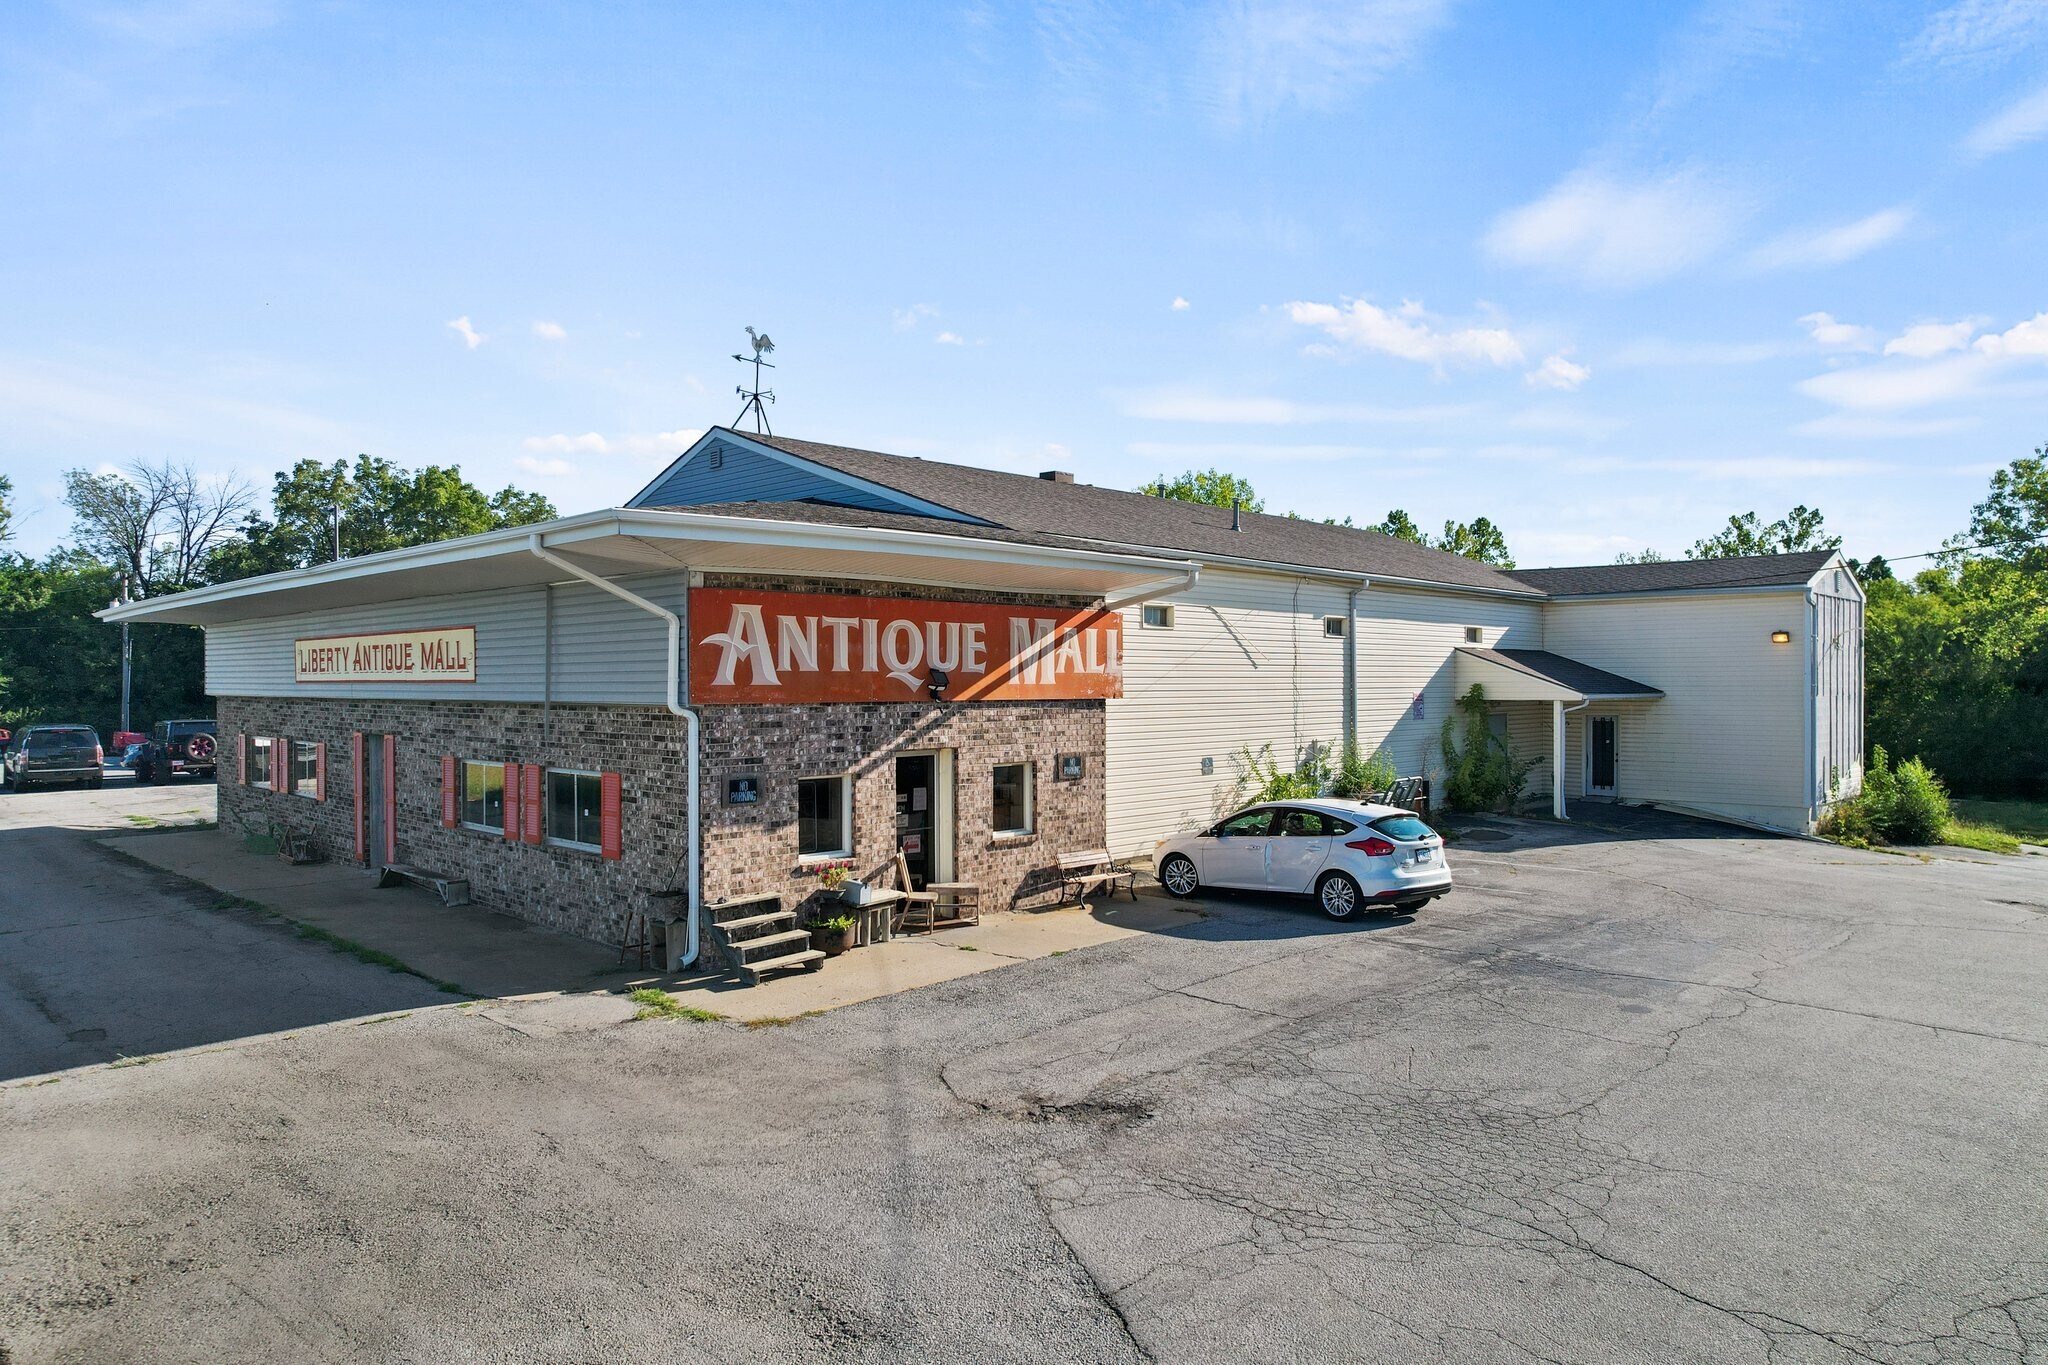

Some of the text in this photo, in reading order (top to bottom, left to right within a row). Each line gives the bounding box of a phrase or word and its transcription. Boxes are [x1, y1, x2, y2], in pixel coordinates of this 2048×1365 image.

[300, 638, 467, 673] LIBERTY ANTIQUE MALL
[699, 603, 987, 692] ANTIQUE
[730, 790, 757, 802] PARKING
[739, 780, 749, 791] NO
